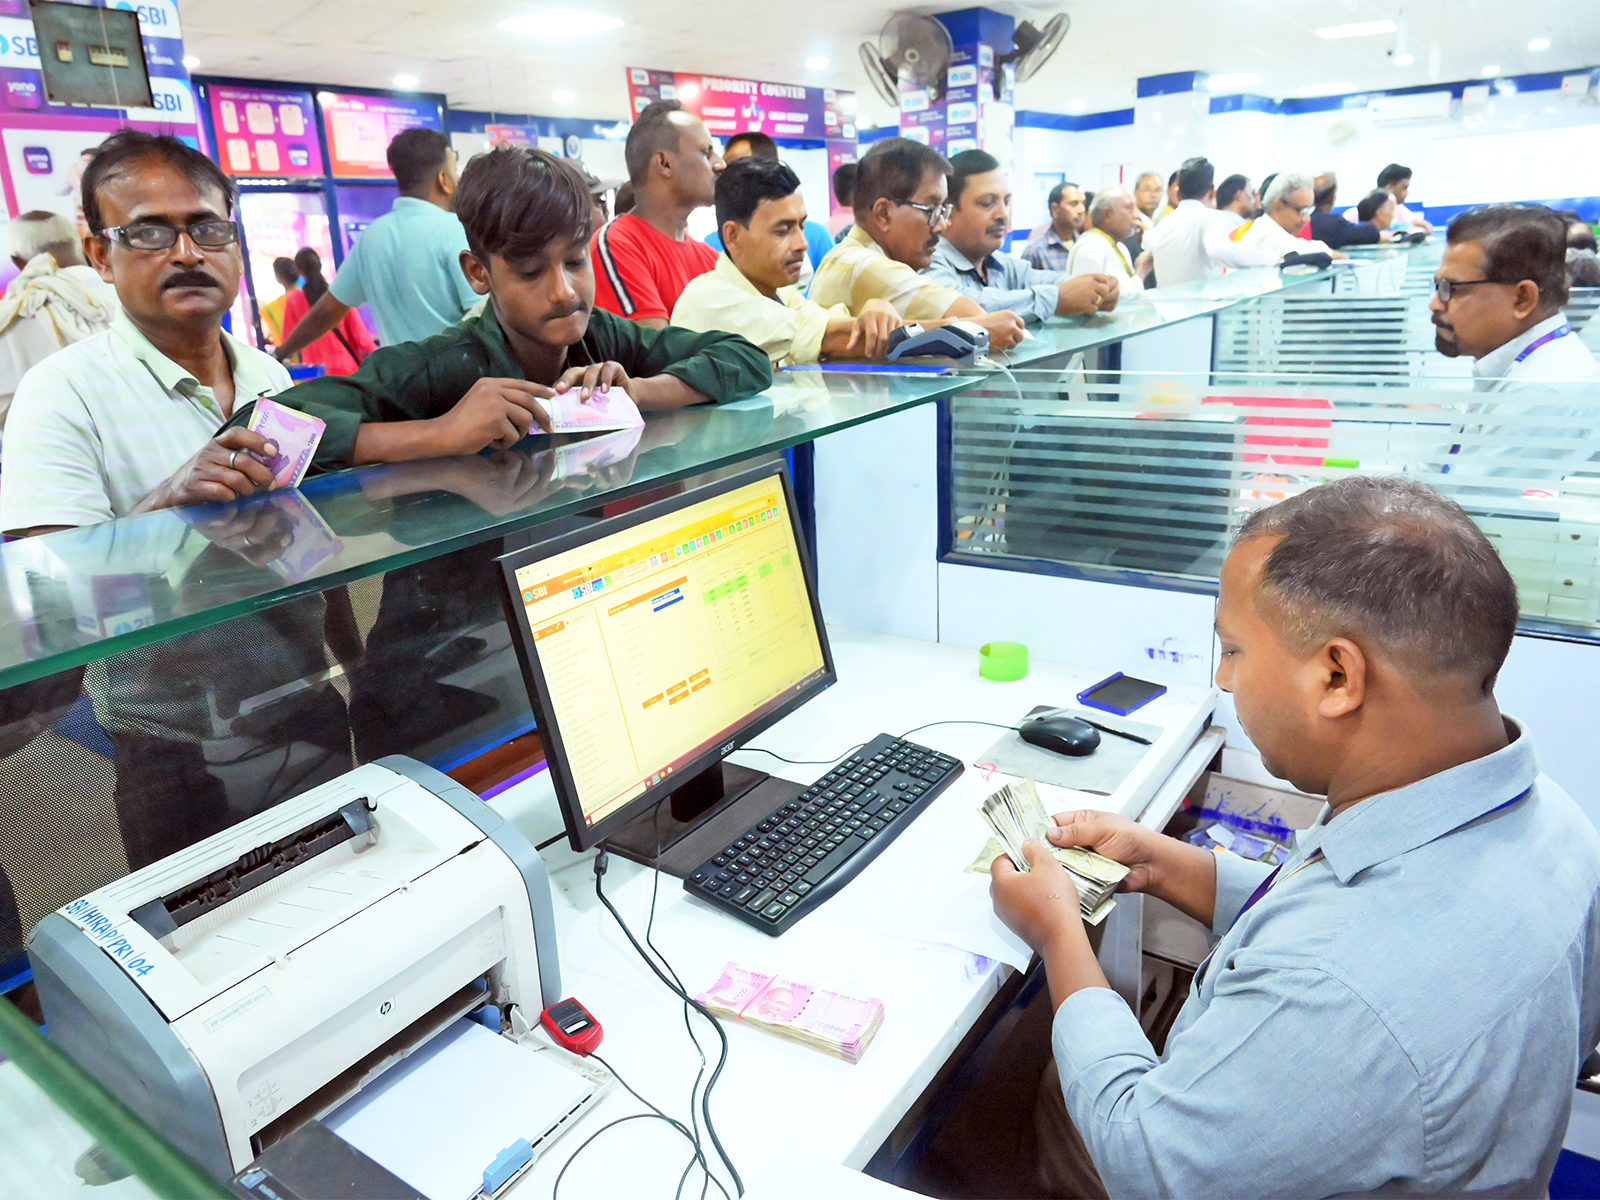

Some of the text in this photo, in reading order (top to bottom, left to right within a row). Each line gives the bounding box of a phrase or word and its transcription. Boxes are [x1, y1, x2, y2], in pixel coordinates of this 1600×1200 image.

[137, 6, 168, 26] SBI
[12, 36, 39, 56] SB
[702, 77, 806, 100] PRIORITY COUNTER
[154, 93, 182, 111] SBI
[532, 585, 548, 599] SBI
[721, 740, 735, 755] acer
